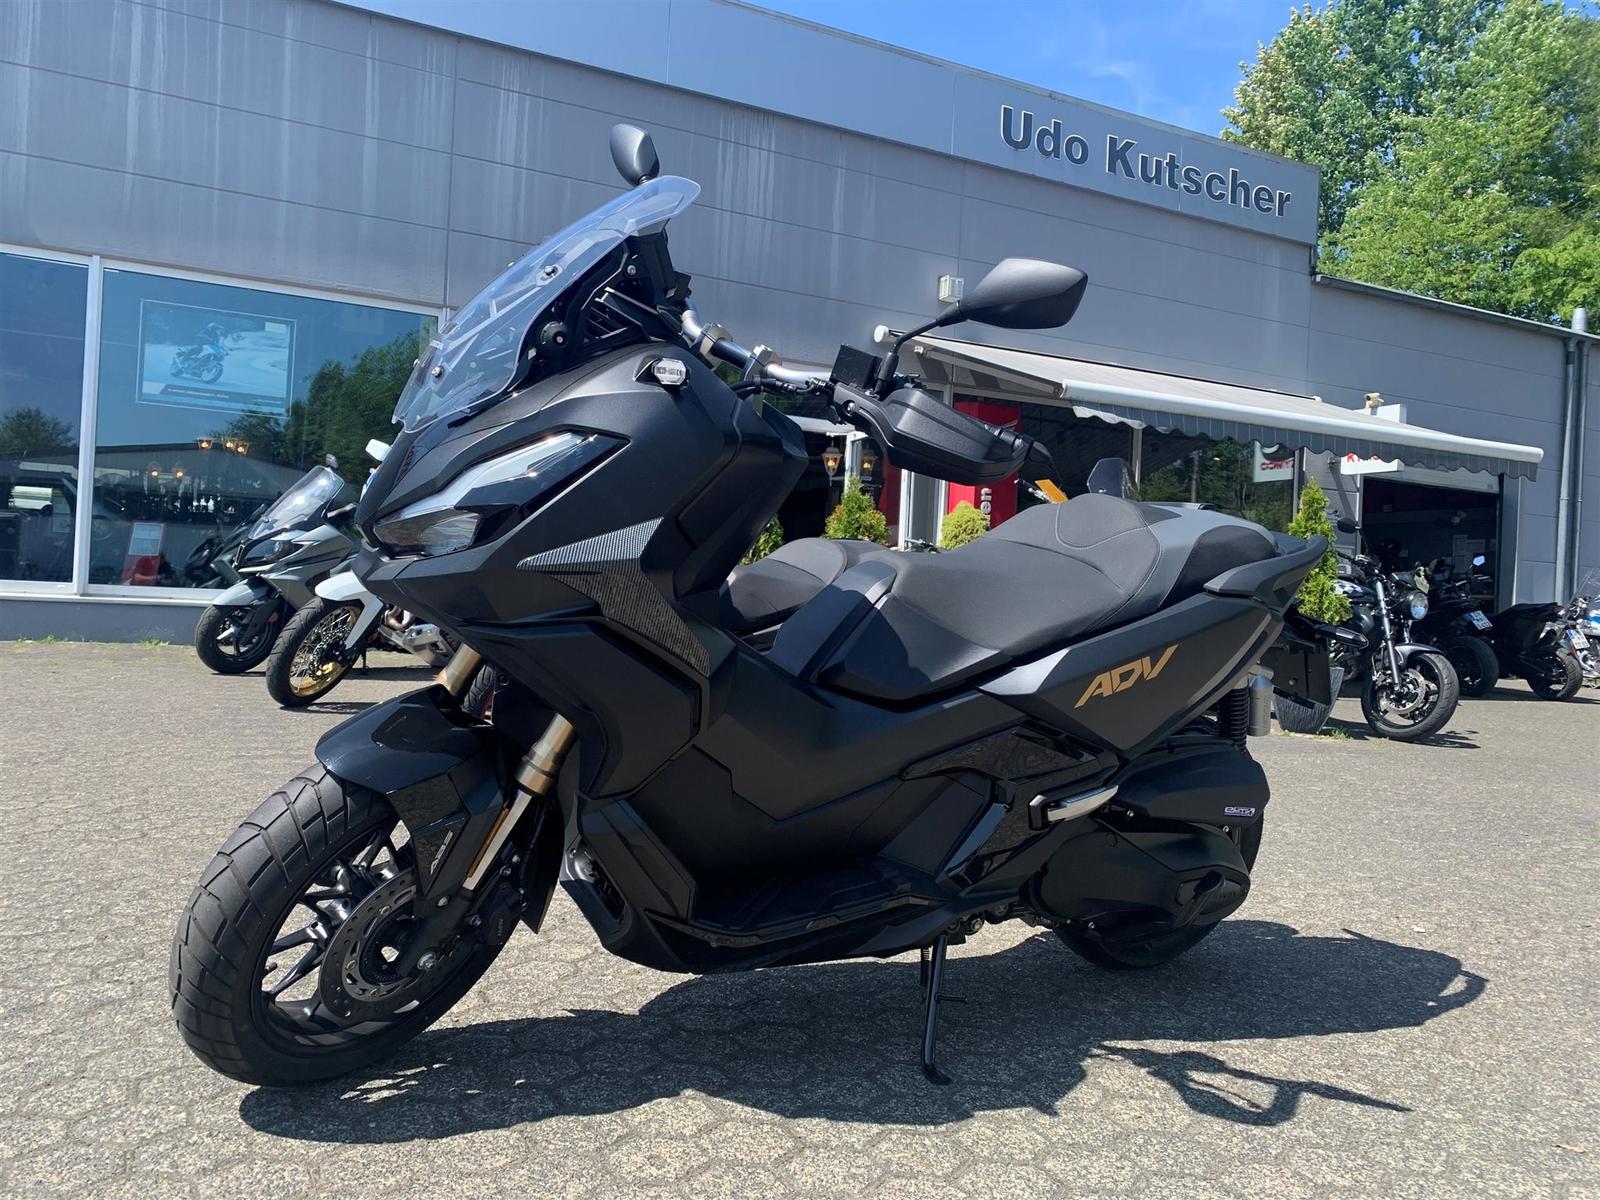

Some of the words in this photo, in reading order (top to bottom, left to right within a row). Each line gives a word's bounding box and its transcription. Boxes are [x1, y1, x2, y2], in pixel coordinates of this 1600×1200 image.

[1000, 104, 1089, 166] Udo
[1105, 134, 1292, 218] Kutscher
[1073, 643, 1179, 709] ADV
